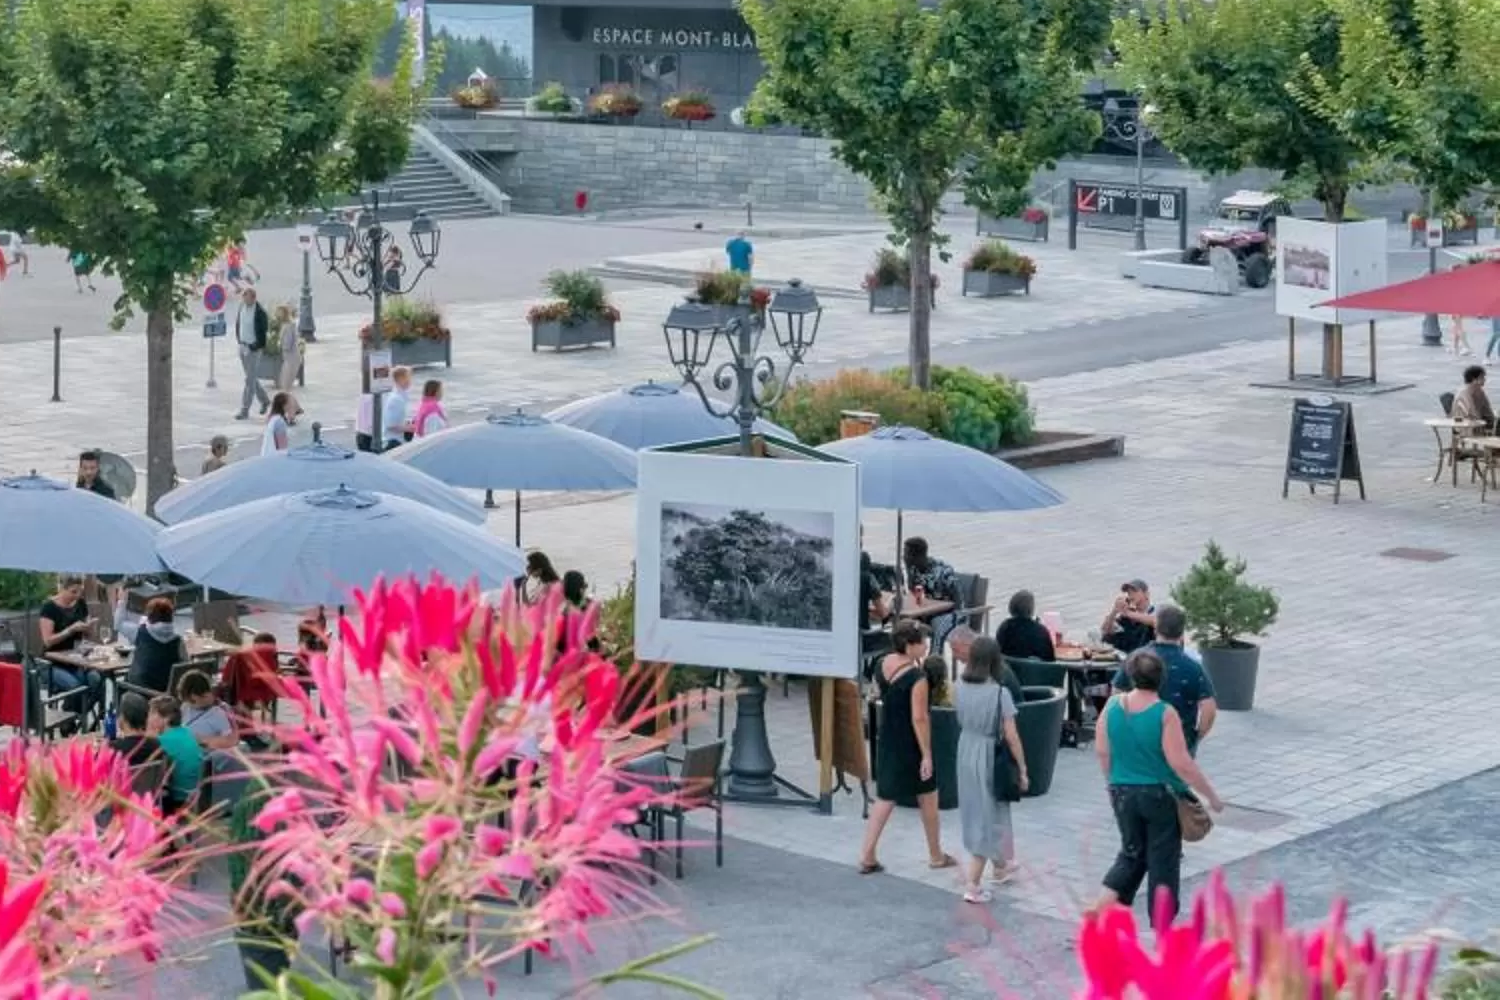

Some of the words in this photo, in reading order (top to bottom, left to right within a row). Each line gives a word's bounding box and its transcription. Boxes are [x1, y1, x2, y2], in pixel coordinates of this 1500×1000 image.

[592, 27, 653, 45] ESPACE
[660, 30, 759, 48] MONT-BLA
[1098, 197, 1114, 212] P1
